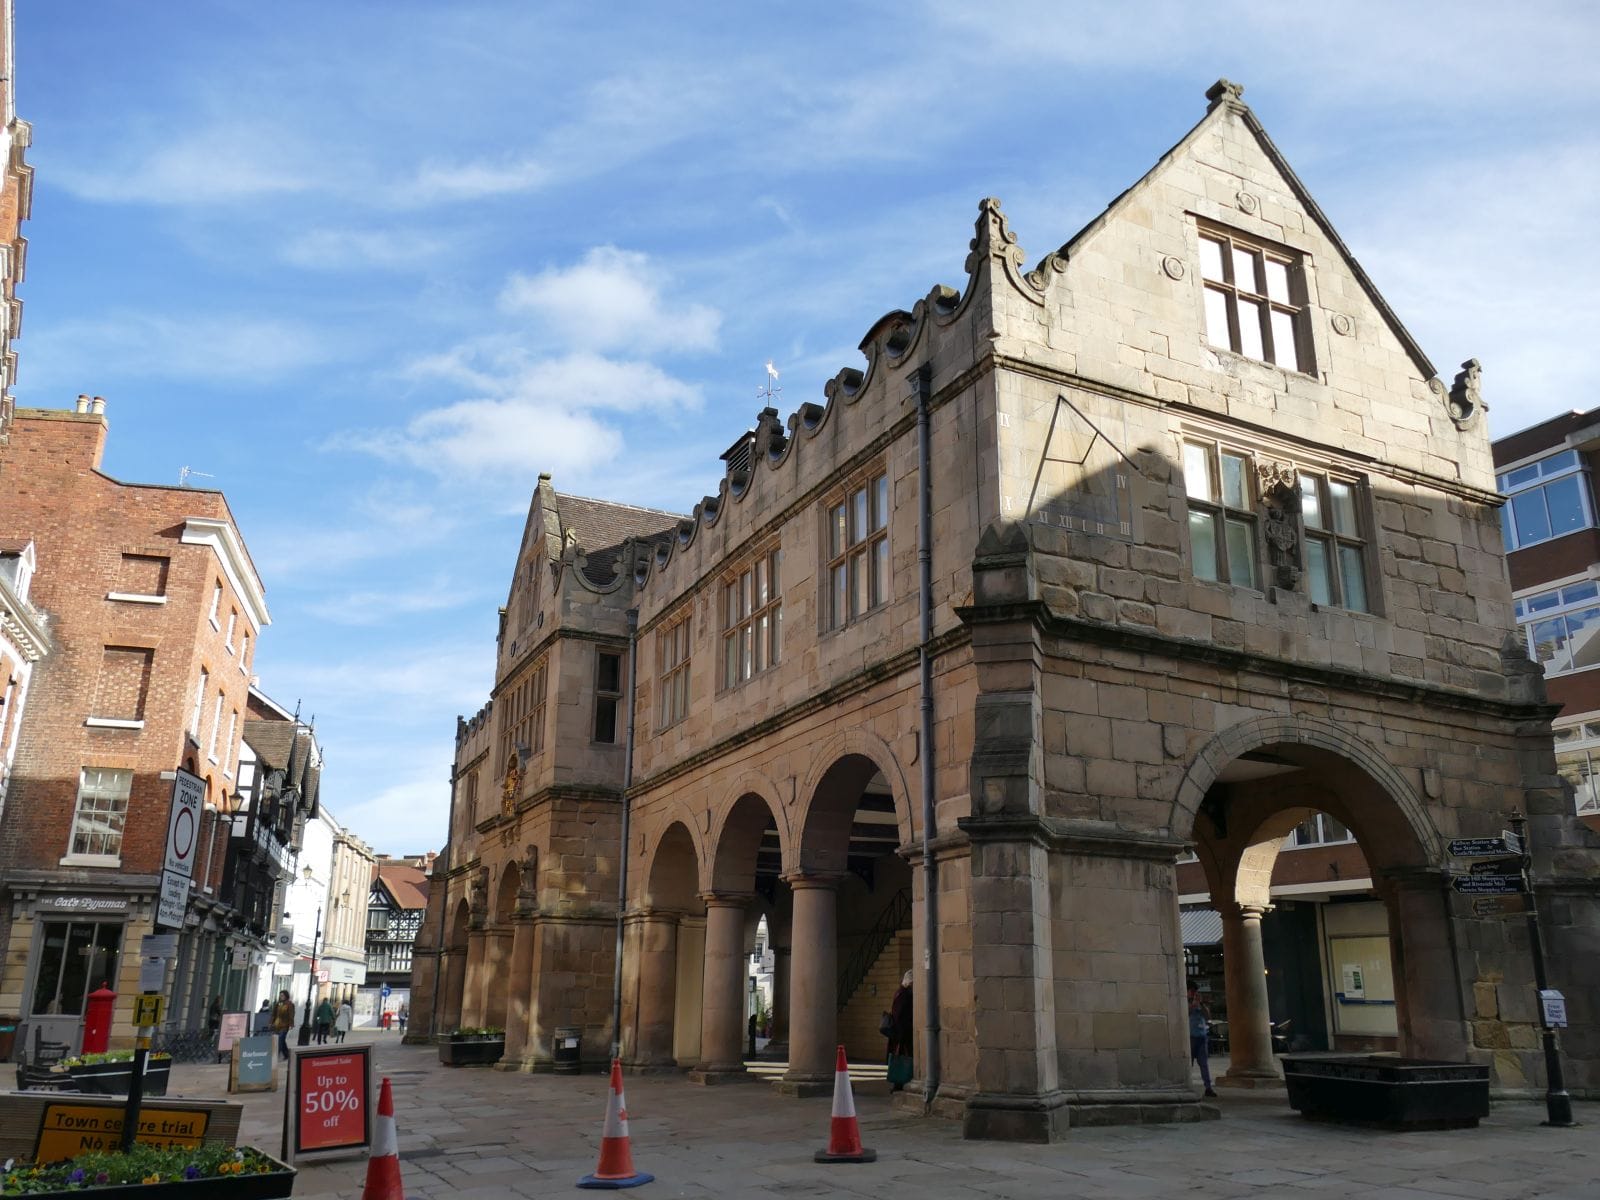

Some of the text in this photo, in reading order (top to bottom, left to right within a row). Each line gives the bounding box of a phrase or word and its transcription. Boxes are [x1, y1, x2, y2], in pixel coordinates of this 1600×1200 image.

[1000, 412, 1010, 427] IX
[1116, 474, 1126, 488] IV
[1005, 496, 1012, 511] X
[1039, 511, 1048, 523] XI
[1059, 515, 1072, 529] XII
[1120, 521, 1130, 535] III
[180, 790, 198, 809] ZONE
[54, 897, 80, 907] Cat's
[81, 897, 127, 910] Pyjamas
[317, 1075, 347, 1088] Up to
[305, 1089, 359, 1113] 50%
[55, 1113, 194, 1134] Town cere trial
[323, 1115, 340, 1128] off
[79, 1136, 103, 1150] No
